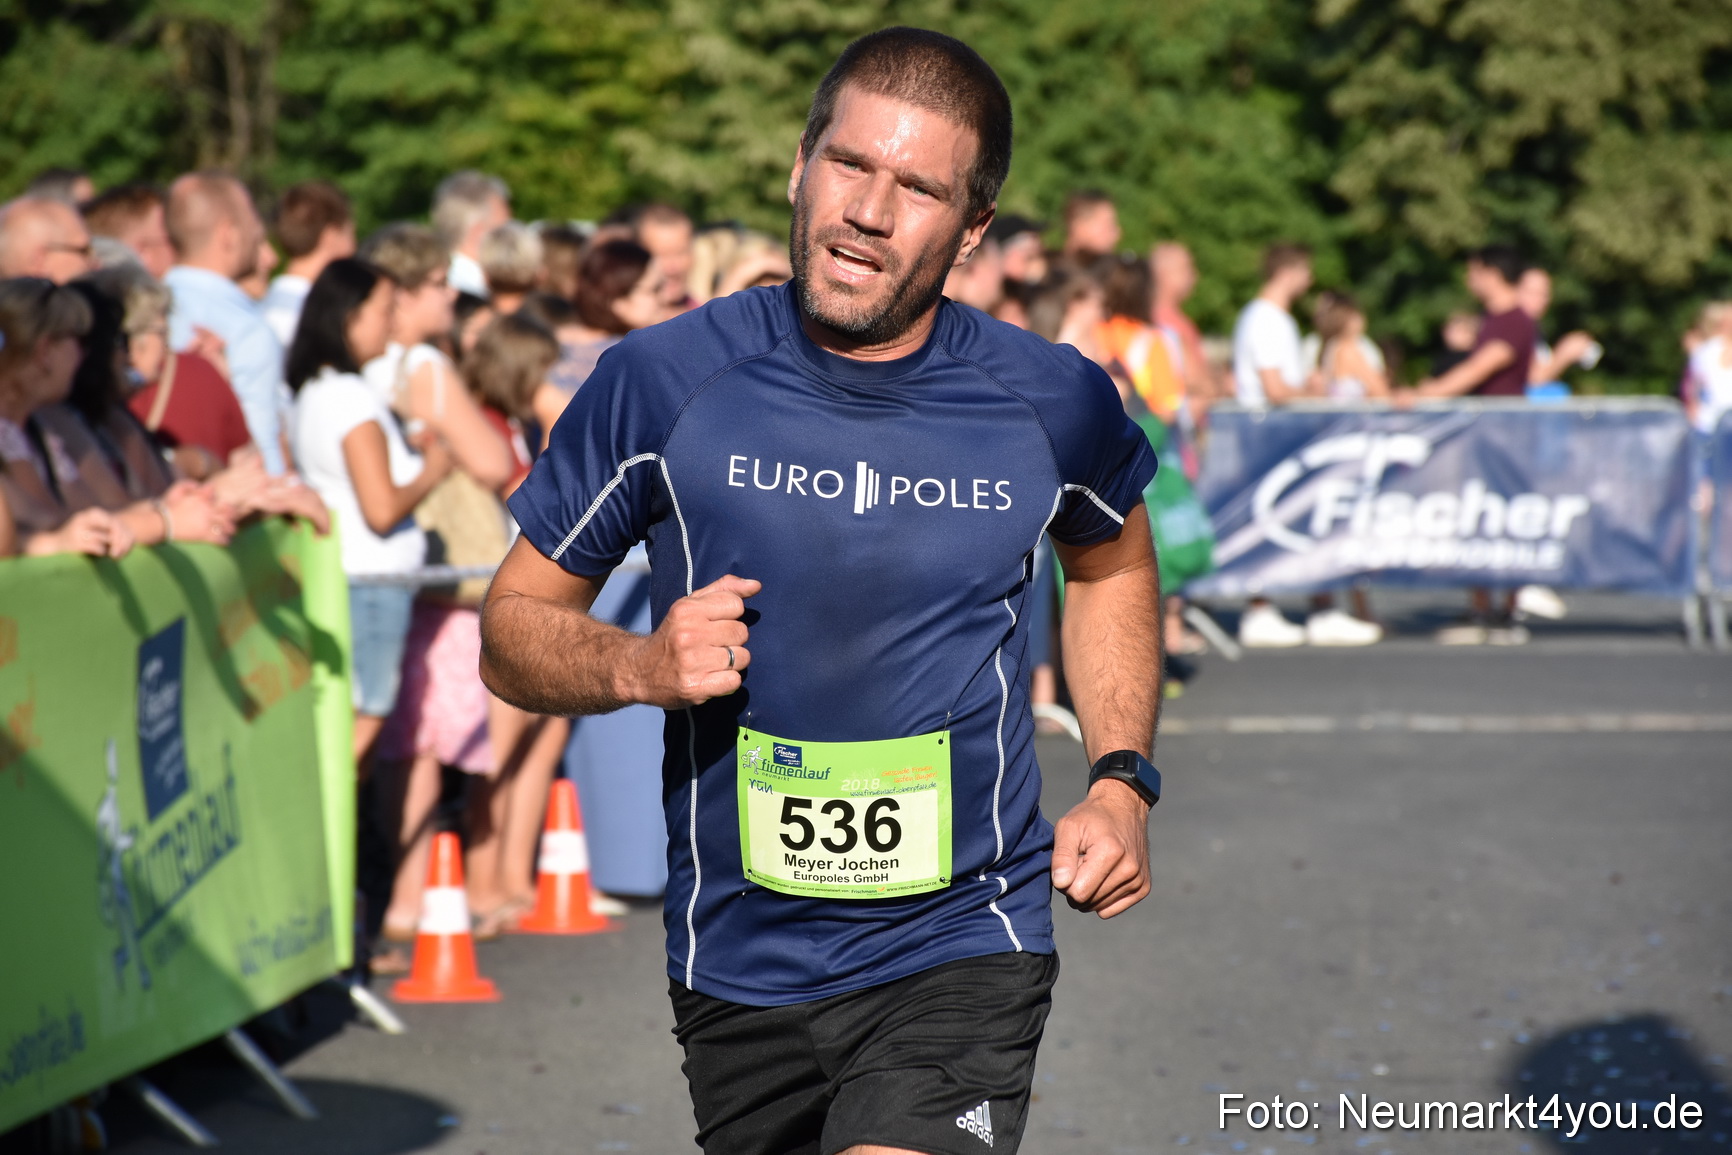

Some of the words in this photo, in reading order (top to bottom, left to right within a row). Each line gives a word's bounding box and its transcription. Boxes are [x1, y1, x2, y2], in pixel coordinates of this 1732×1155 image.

[728, 455, 844, 499] EURO
[889, 475, 1012, 511] POLES
[1310, 478, 1589, 539] Fischer
[761, 759, 832, 780] firmenlauf
[762, 772, 790, 781] neumarkt
[841, 778, 880, 791] 2018
[779, 796, 902, 854] 536
[784, 853, 833, 871] Meyer
[838, 858, 899, 870] Jochen
[793, 871, 850, 883] Europoles
[853, 872, 889, 883] GmbH
